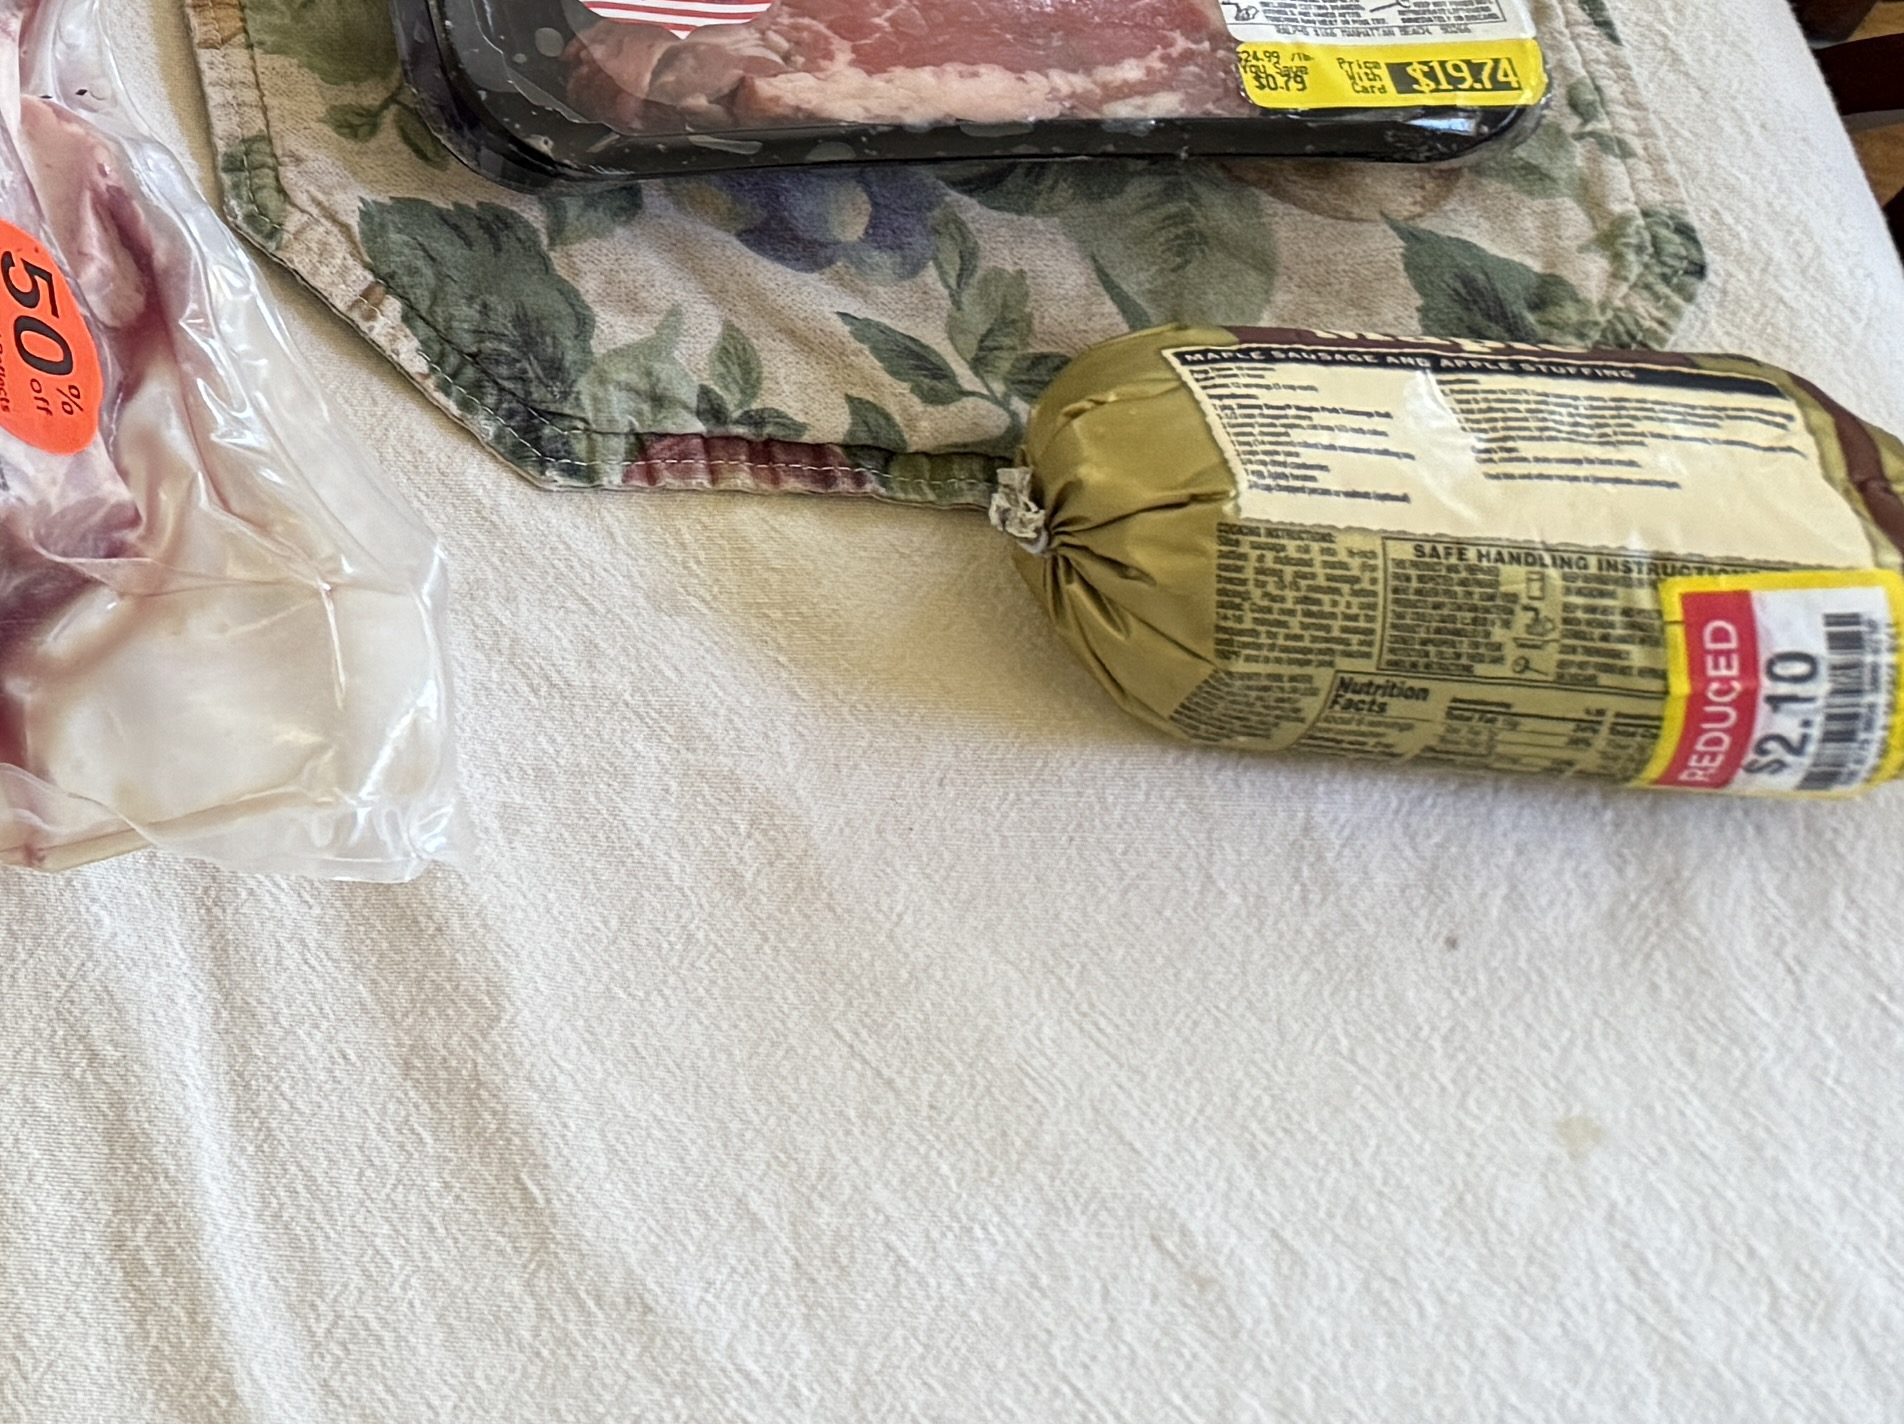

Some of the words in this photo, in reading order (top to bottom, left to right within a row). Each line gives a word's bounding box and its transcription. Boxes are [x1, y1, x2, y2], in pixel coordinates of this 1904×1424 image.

[1410, 57, 1519, 93] $19.74
[1182, 348, 1268, 367] MAPLE
[1271, 350, 1380, 369] SAUSAGE
[1384, 351, 1433, 369] AND
[1437, 355, 1514, 374] APPLE
[1519, 358, 1640, 382] STUFFING
[1678, 617, 1739, 782] REDUCED
[1742, 649, 1821, 777] $2.10
